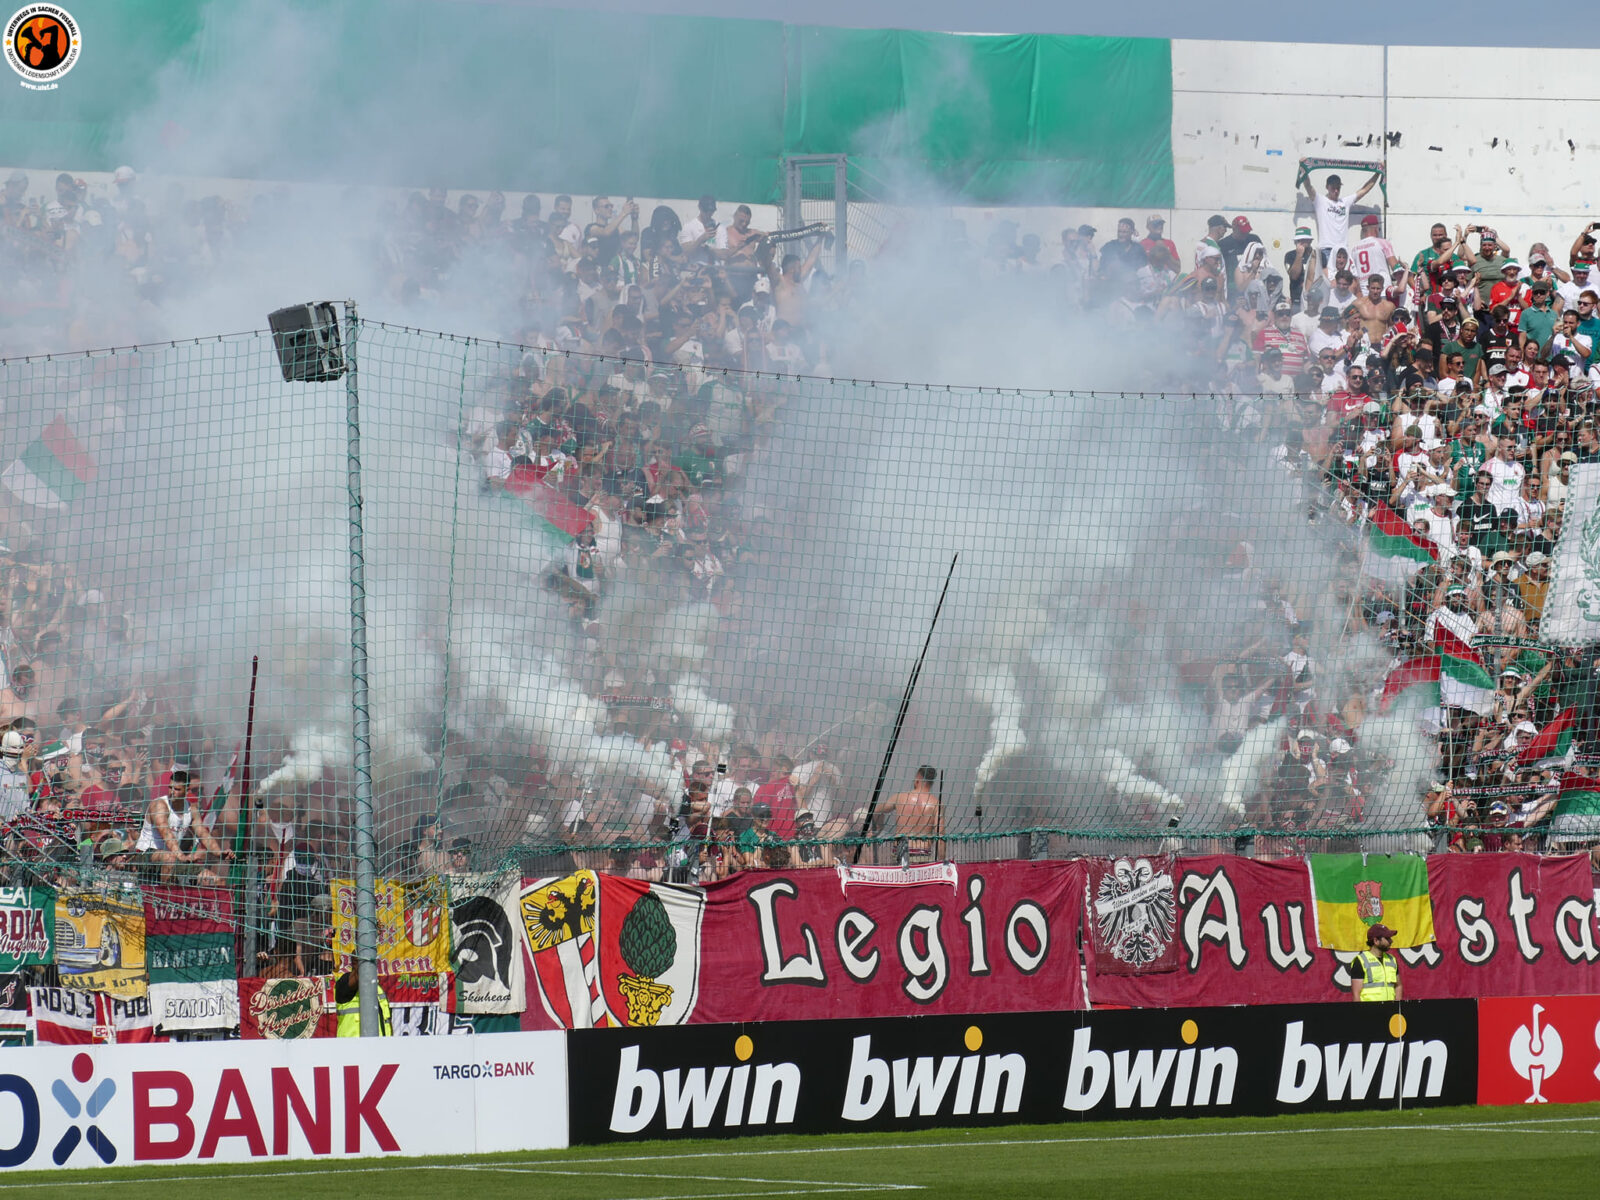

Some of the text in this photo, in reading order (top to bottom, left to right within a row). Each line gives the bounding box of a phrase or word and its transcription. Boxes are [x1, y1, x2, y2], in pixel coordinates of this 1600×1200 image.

[1359, 250, 1370, 274] 9
[748, 874, 1050, 1004] Legio
[609, 1035, 801, 1134] bwin
[841, 1026, 1027, 1122] bwin
[1063, 1019, 1239, 1112] bwin
[1276, 1013, 1448, 1104] bwin
